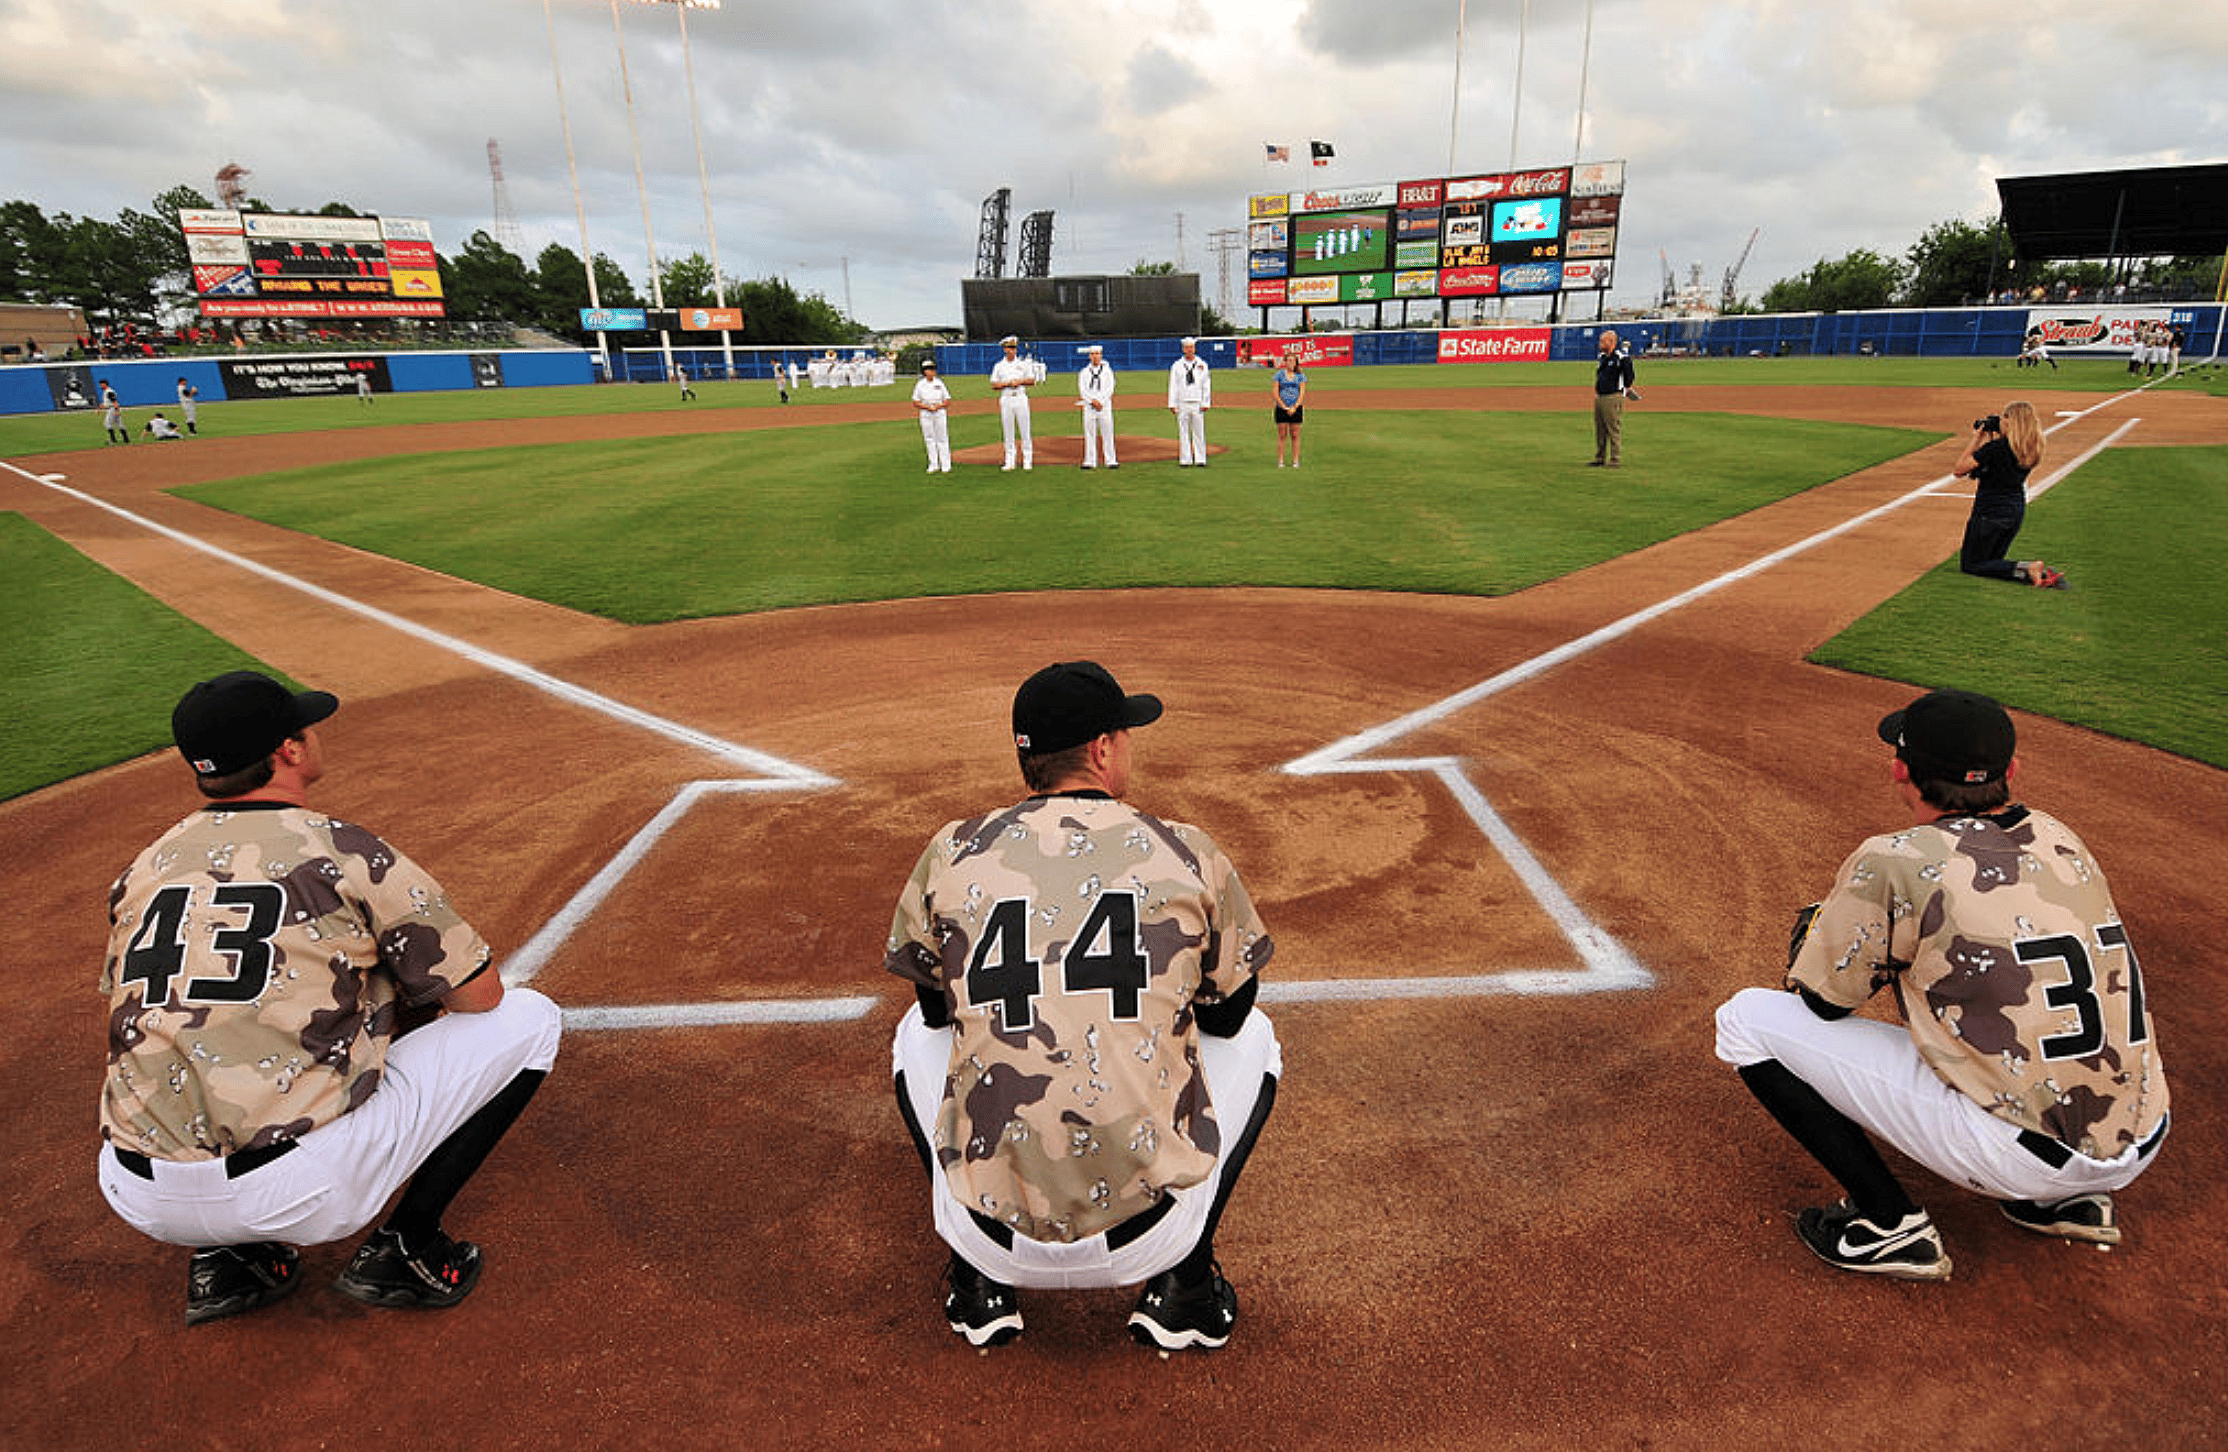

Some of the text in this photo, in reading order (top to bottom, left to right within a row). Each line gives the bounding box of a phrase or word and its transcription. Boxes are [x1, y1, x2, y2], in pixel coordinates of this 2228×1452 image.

[1402, 186, 1439, 203] BB&T
[1510, 172, 1563, 195] Coca-Cola
[1458, 337, 1547, 356] State Farm
[256, 363, 285, 374] HOW
[286, 362, 309, 373] YOU
[120, 882, 287, 1008] 43
[967, 889, 1151, 1031] 44
[2012, 922, 2149, 1061] 37
